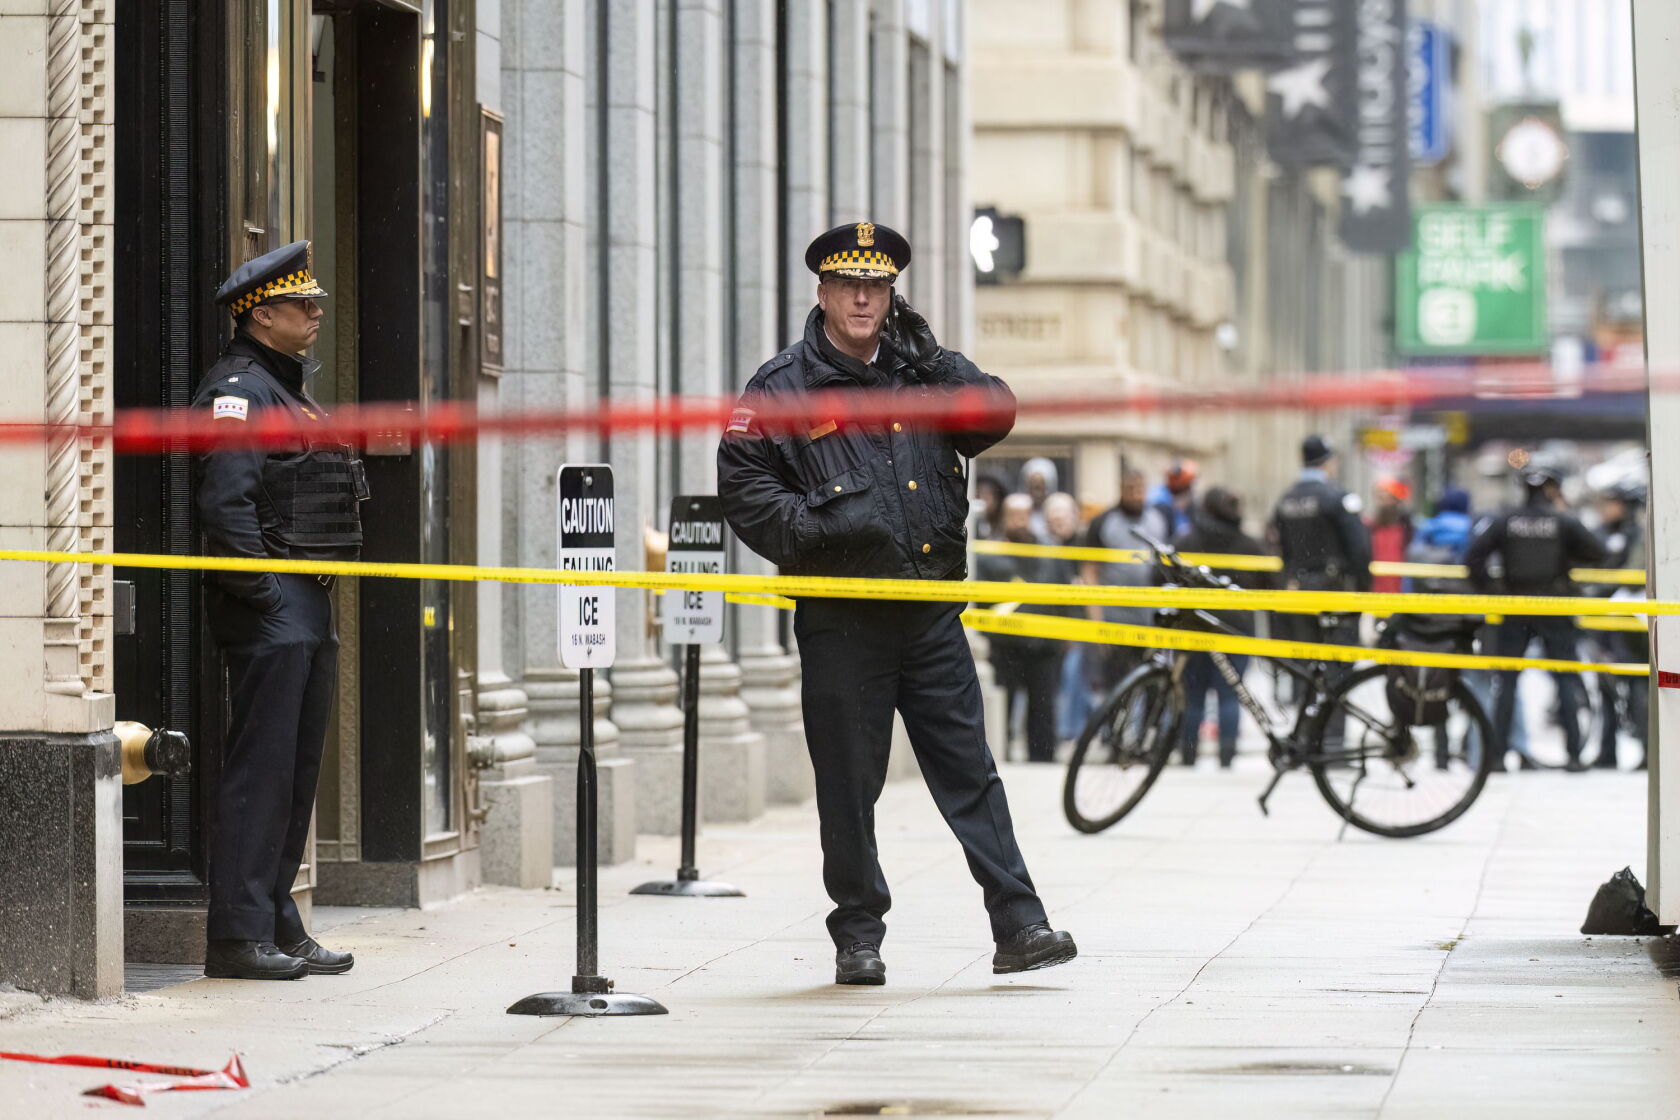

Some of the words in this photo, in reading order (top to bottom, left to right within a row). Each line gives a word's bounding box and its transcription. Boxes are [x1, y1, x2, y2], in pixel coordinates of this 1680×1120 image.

[562, 498, 613, 534] CAUTION
[671, 522, 721, 544] CAUTION
[579, 596, 598, 626] ICE
[684, 591, 703, 609] ICE
[585, 633, 606, 645] WABASH
